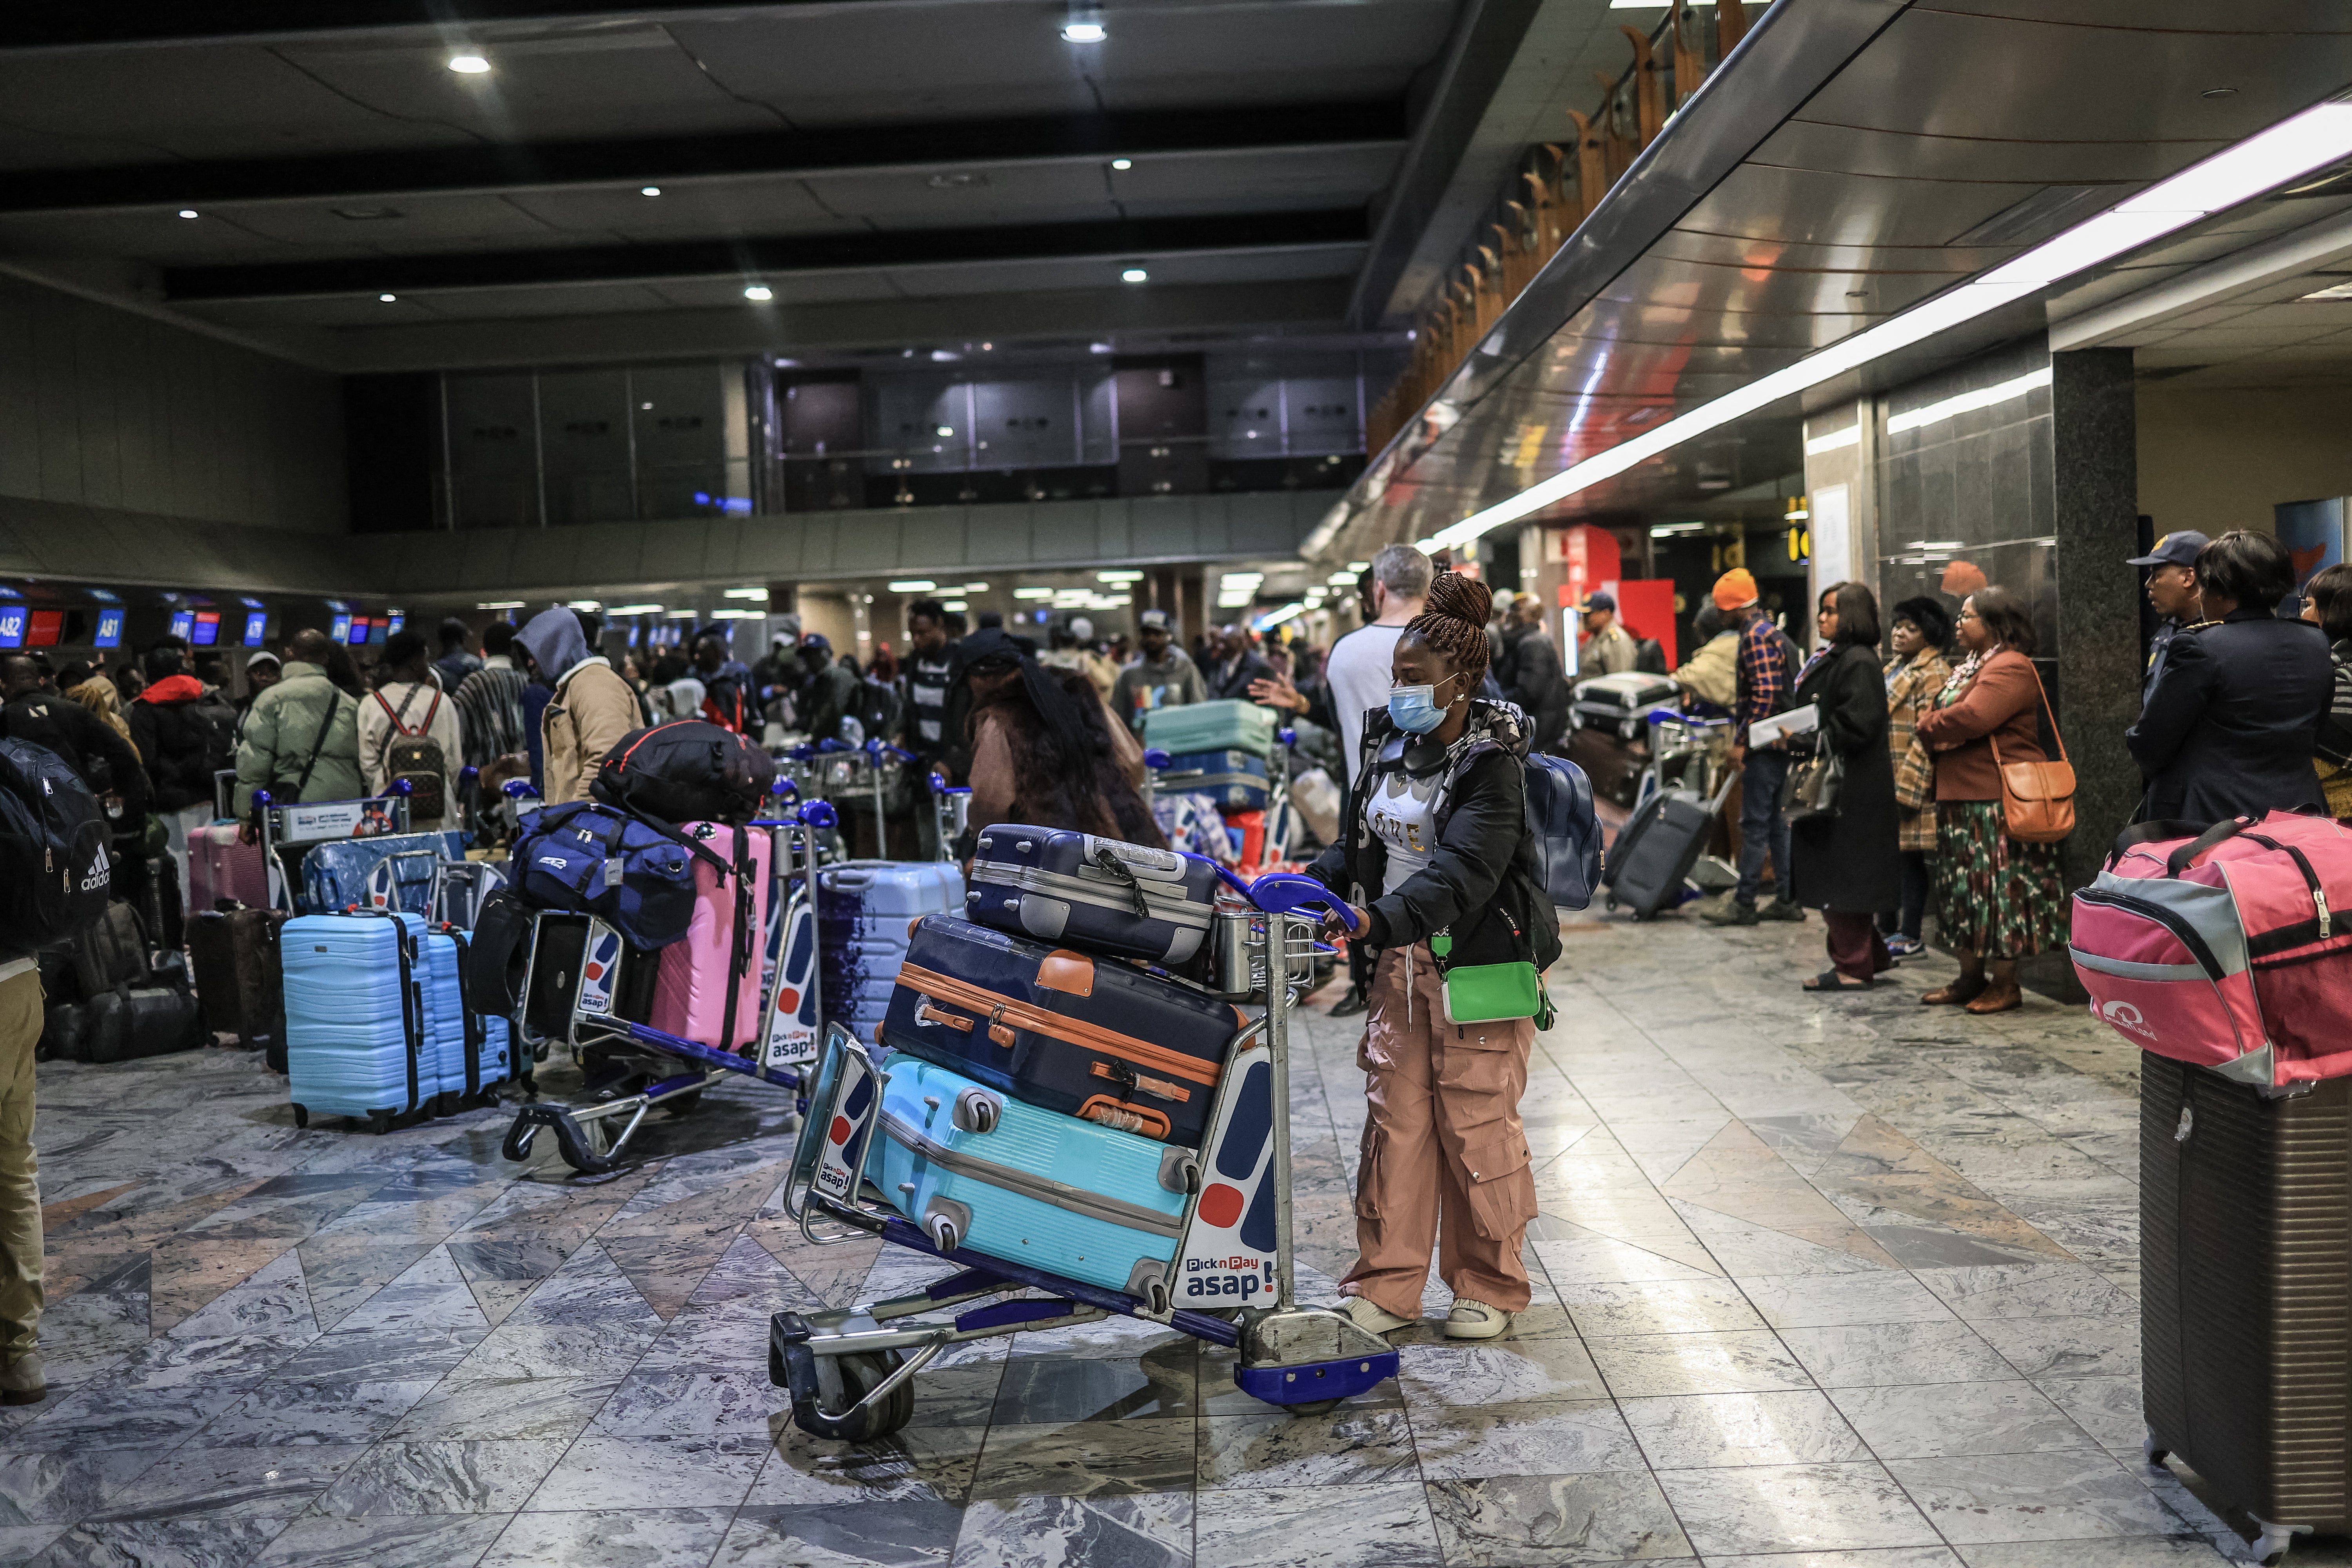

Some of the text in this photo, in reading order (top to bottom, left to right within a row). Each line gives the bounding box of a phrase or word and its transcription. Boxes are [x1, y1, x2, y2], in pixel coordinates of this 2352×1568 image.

[0, 616, 21, 637] A82
[81, 870, 110, 891] adidas
[582, 998, 608, 1008] asap!
[773, 1033, 815, 1057] asap!
[820, 1171, 849, 1190] asap!
[823, 1163, 833, 1171] Pick
[836, 1168, 846, 1178] Pay
[1187, 1256, 1259, 1272] Pick n Pay
[1187, 1261, 1273, 1301] asap!
